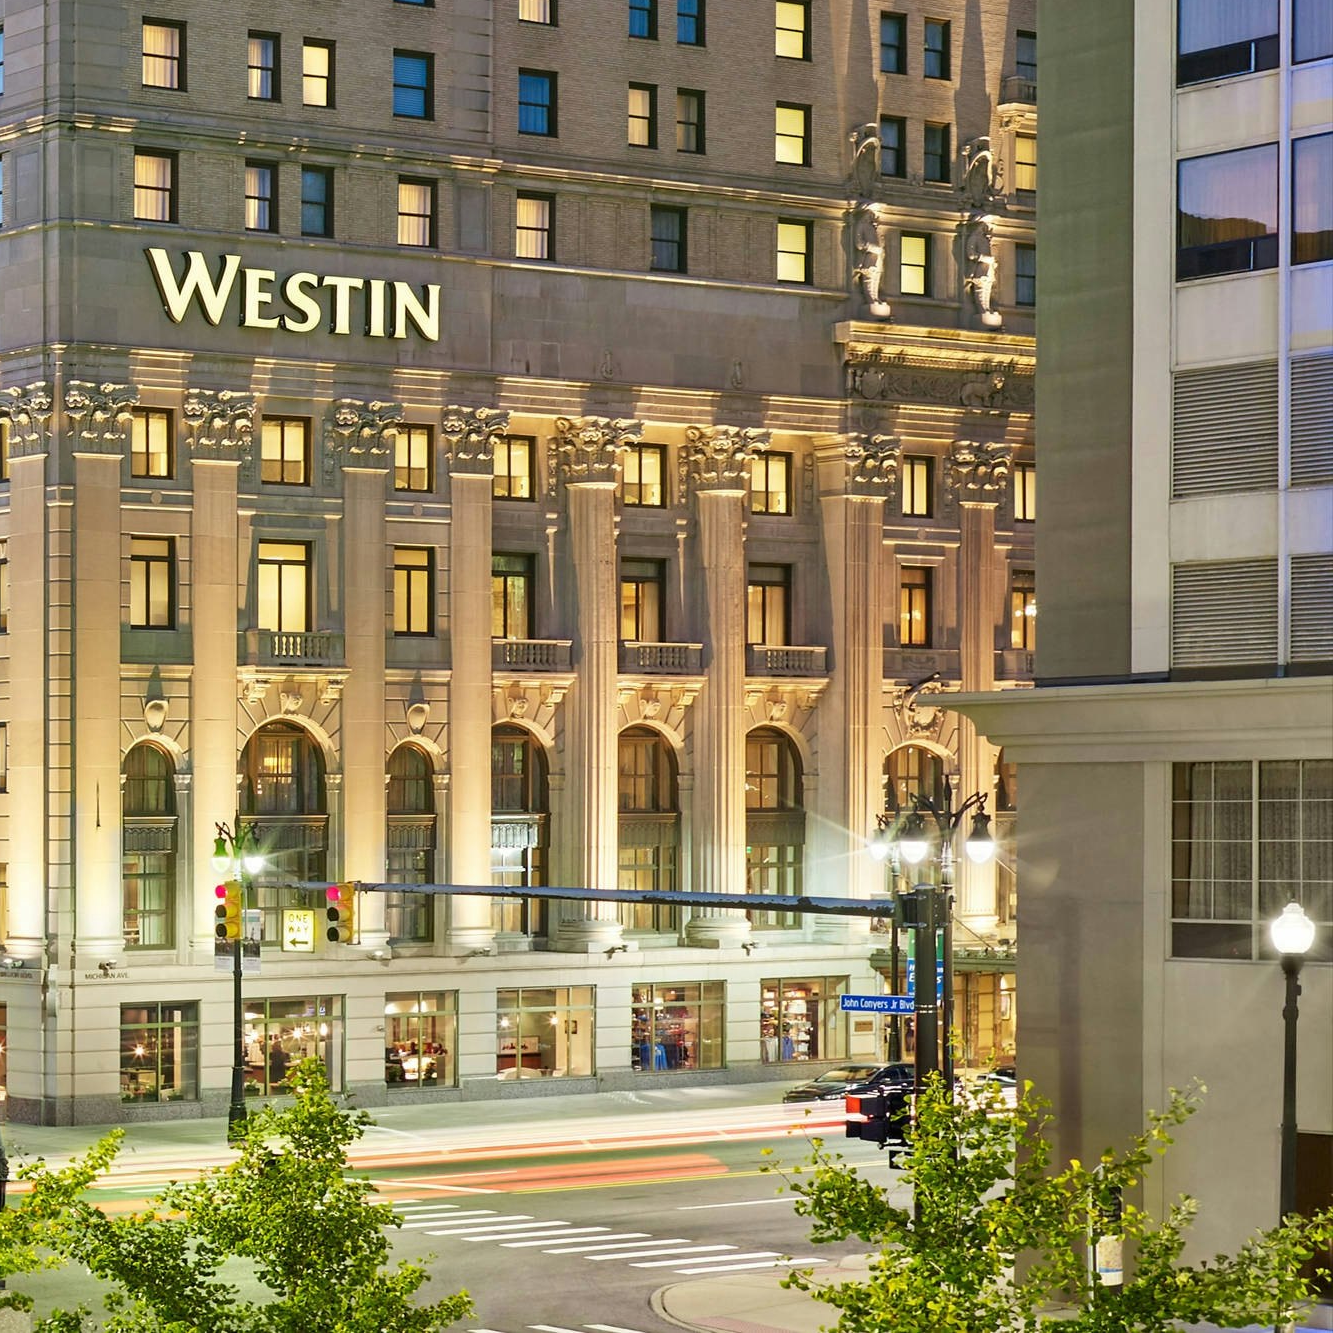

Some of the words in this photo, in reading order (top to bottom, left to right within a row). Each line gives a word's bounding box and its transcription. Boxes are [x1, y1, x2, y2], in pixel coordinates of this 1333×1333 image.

[144, 247, 442, 342] WESTIN
[288, 913, 308, 923] ONE
[843, 998, 859, 1008] John
[860, 998, 889, 1010] Conyers
[890, 999, 898, 1010] Jr
[899, 999, 915, 1010] Blvd
